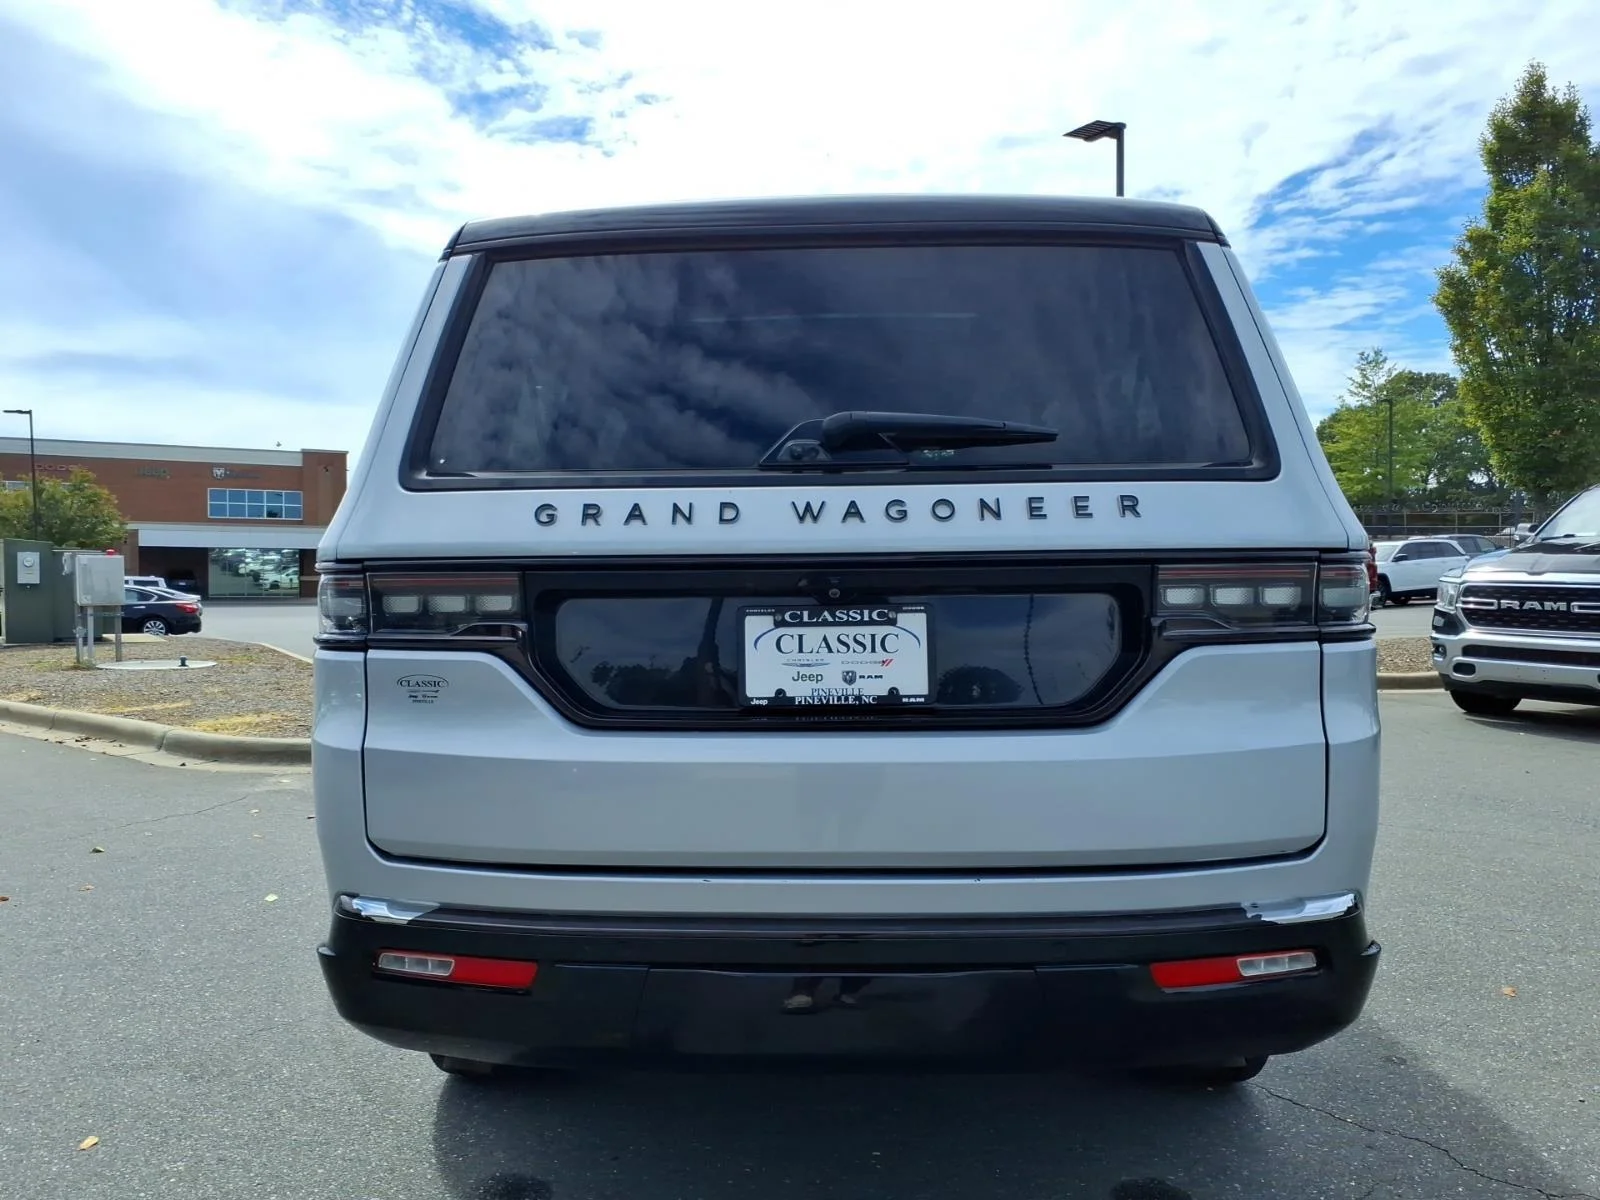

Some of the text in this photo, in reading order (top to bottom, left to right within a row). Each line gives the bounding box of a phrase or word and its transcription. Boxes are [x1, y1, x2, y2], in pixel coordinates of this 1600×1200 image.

[534, 494, 1142, 527] GRAND WAGONEER
[1500, 599, 1567, 611] RAM
[784, 609, 889, 623] CLASSIC
[775, 633, 899, 654] CLASSIC
[792, 671, 824, 684] Jeep
[400, 680, 446, 688] CLASSIC
[811, 687, 865, 696] PINEVILLE
[750, 698, 769, 706] Jeep
[795, 695, 878, 705] PINEVILLE, NC
